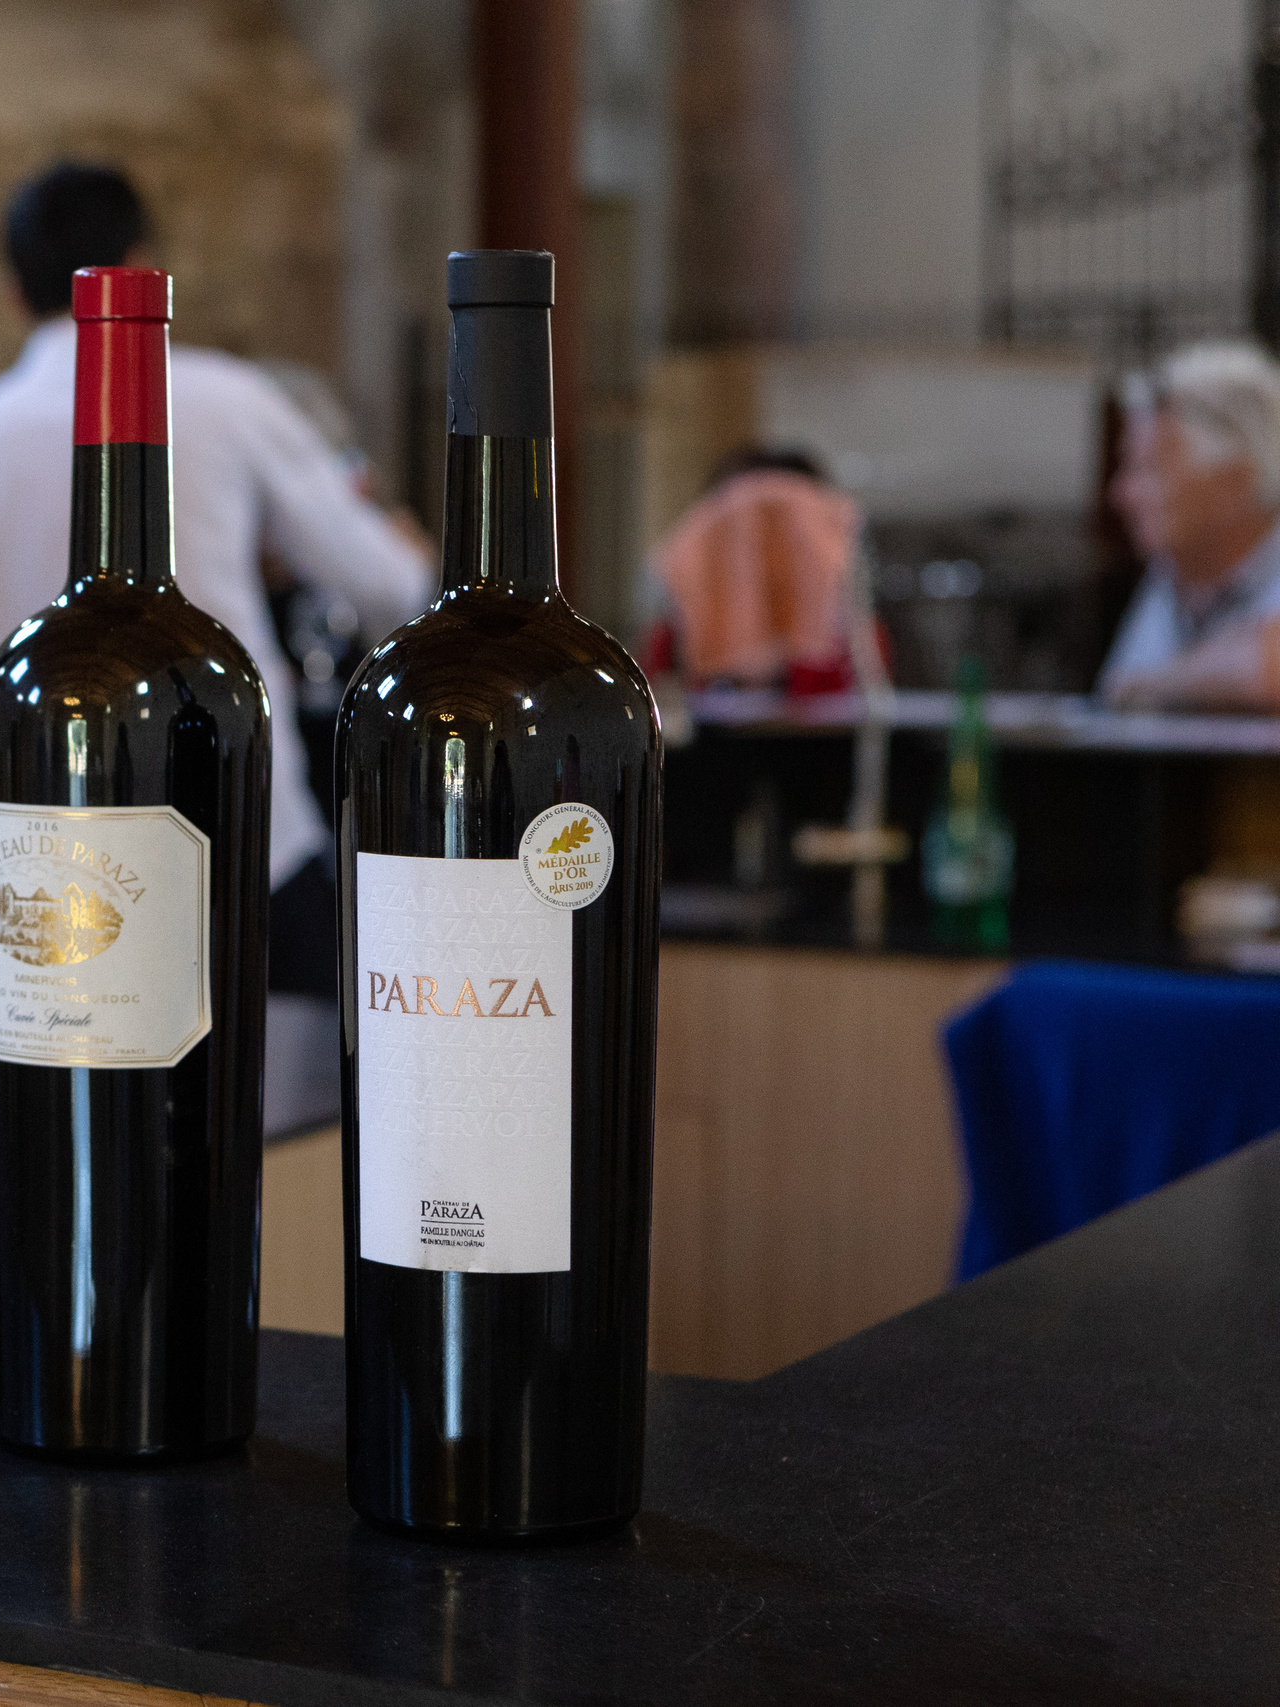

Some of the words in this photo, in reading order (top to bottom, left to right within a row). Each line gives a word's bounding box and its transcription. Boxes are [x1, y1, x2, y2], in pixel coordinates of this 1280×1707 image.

[26, 820, 59, 832] 2016
[524, 811, 554, 845] CONCOURS
[554, 804, 585, 815] GÉNÉRAL
[585, 809, 609, 836] AGRICOLE
[537, 851, 602, 869] MÉDAILLE
[39, 835, 67, 857] DE
[71, 841, 147, 904] PARAZA
[553, 866, 589, 881] D'OR
[549, 881, 574, 895] PARIS
[575, 880, 594, 891] 2019
[533, 885, 542, 895] DE
[540, 891, 582, 908] L'AGRICULTURE
[581, 896, 589, 904] ET
[589, 892, 596, 901] DE
[14, 974, 78, 987] MINERVOIS
[9, 989, 27, 999] VIN
[32, 991, 49, 1002] DU
[53, 992, 141, 1004] LANGUEDOC
[367, 970, 557, 1018] PARAZA
[115, 1047, 146, 1055] FRANCE
[420, 1199, 485, 1220] PARAZA
[420, 1225, 450, 1236] FAMILLE
[450, 1227, 486, 1238] DANGLAS
